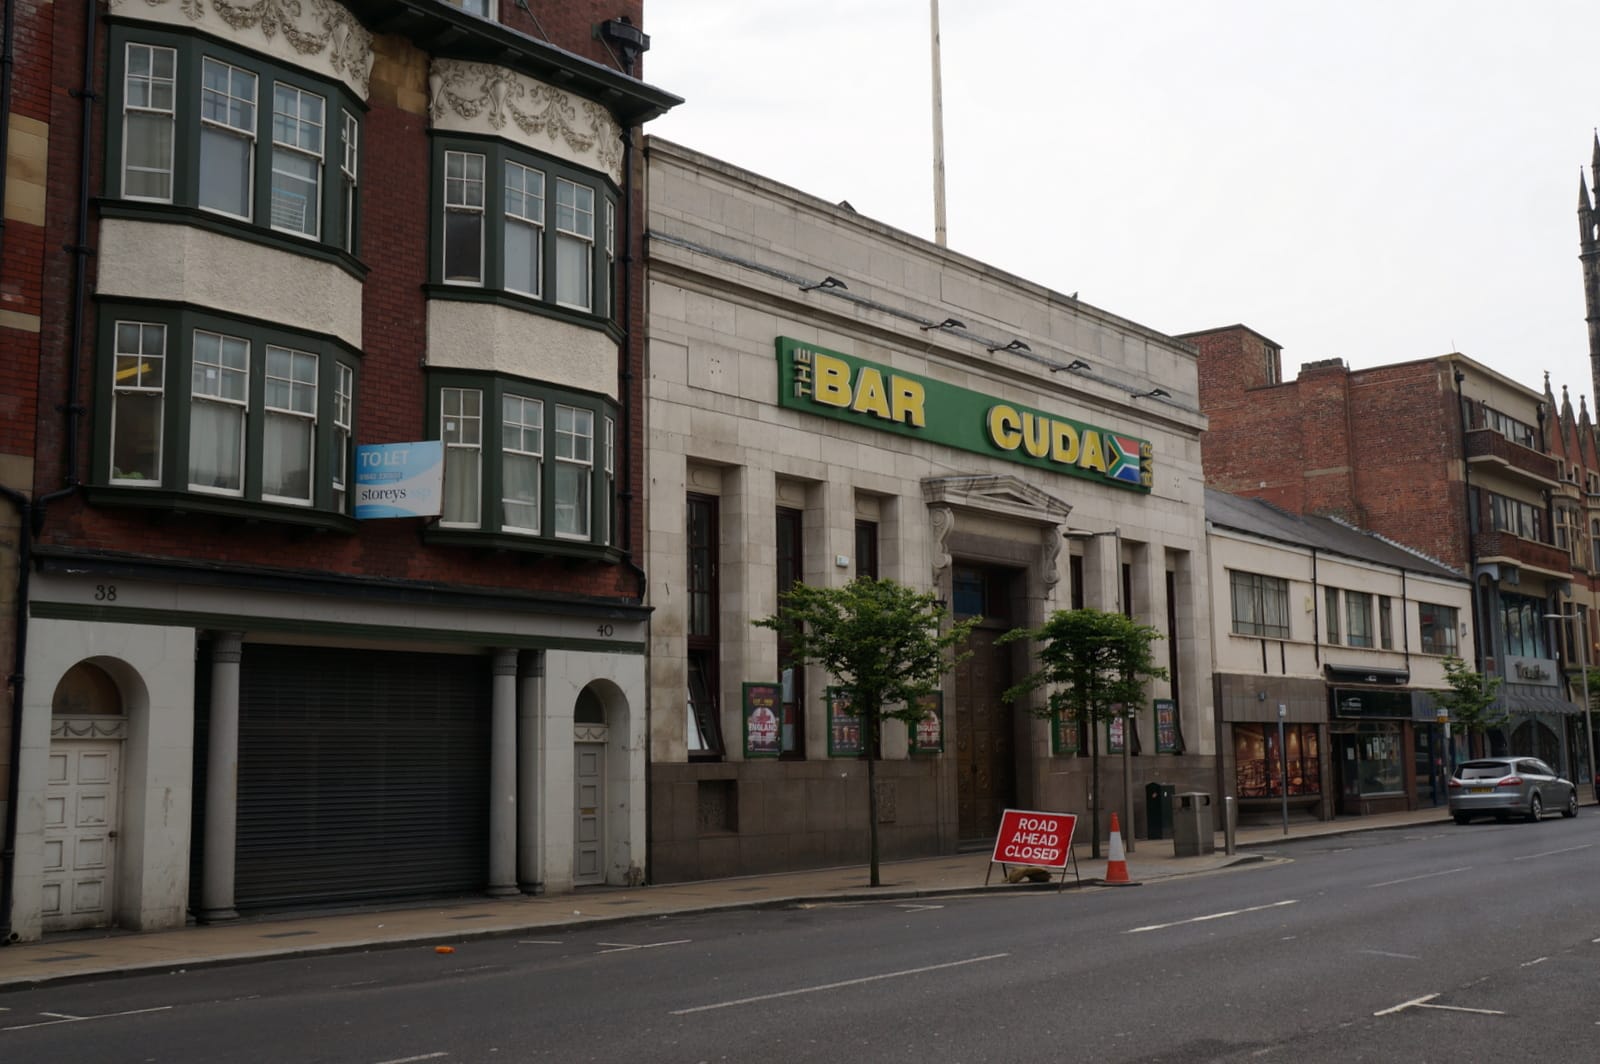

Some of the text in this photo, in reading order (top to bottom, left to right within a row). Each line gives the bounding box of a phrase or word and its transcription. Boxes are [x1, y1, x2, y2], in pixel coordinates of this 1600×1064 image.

[793, 348, 811, 398] THE
[812, 353, 1106, 473] BAR CUDA
[361, 450, 409, 467] TO LET
[1141, 441, 1154, 488] BAR
[361, 488, 406, 503] storeys
[95, 585, 117, 601] 38
[597, 624, 614, 637] 40
[1018, 818, 1058, 832] ROAD
[1011, 831, 1058, 846] AHEAD
[1004, 845, 1059, 860] CLOSED
